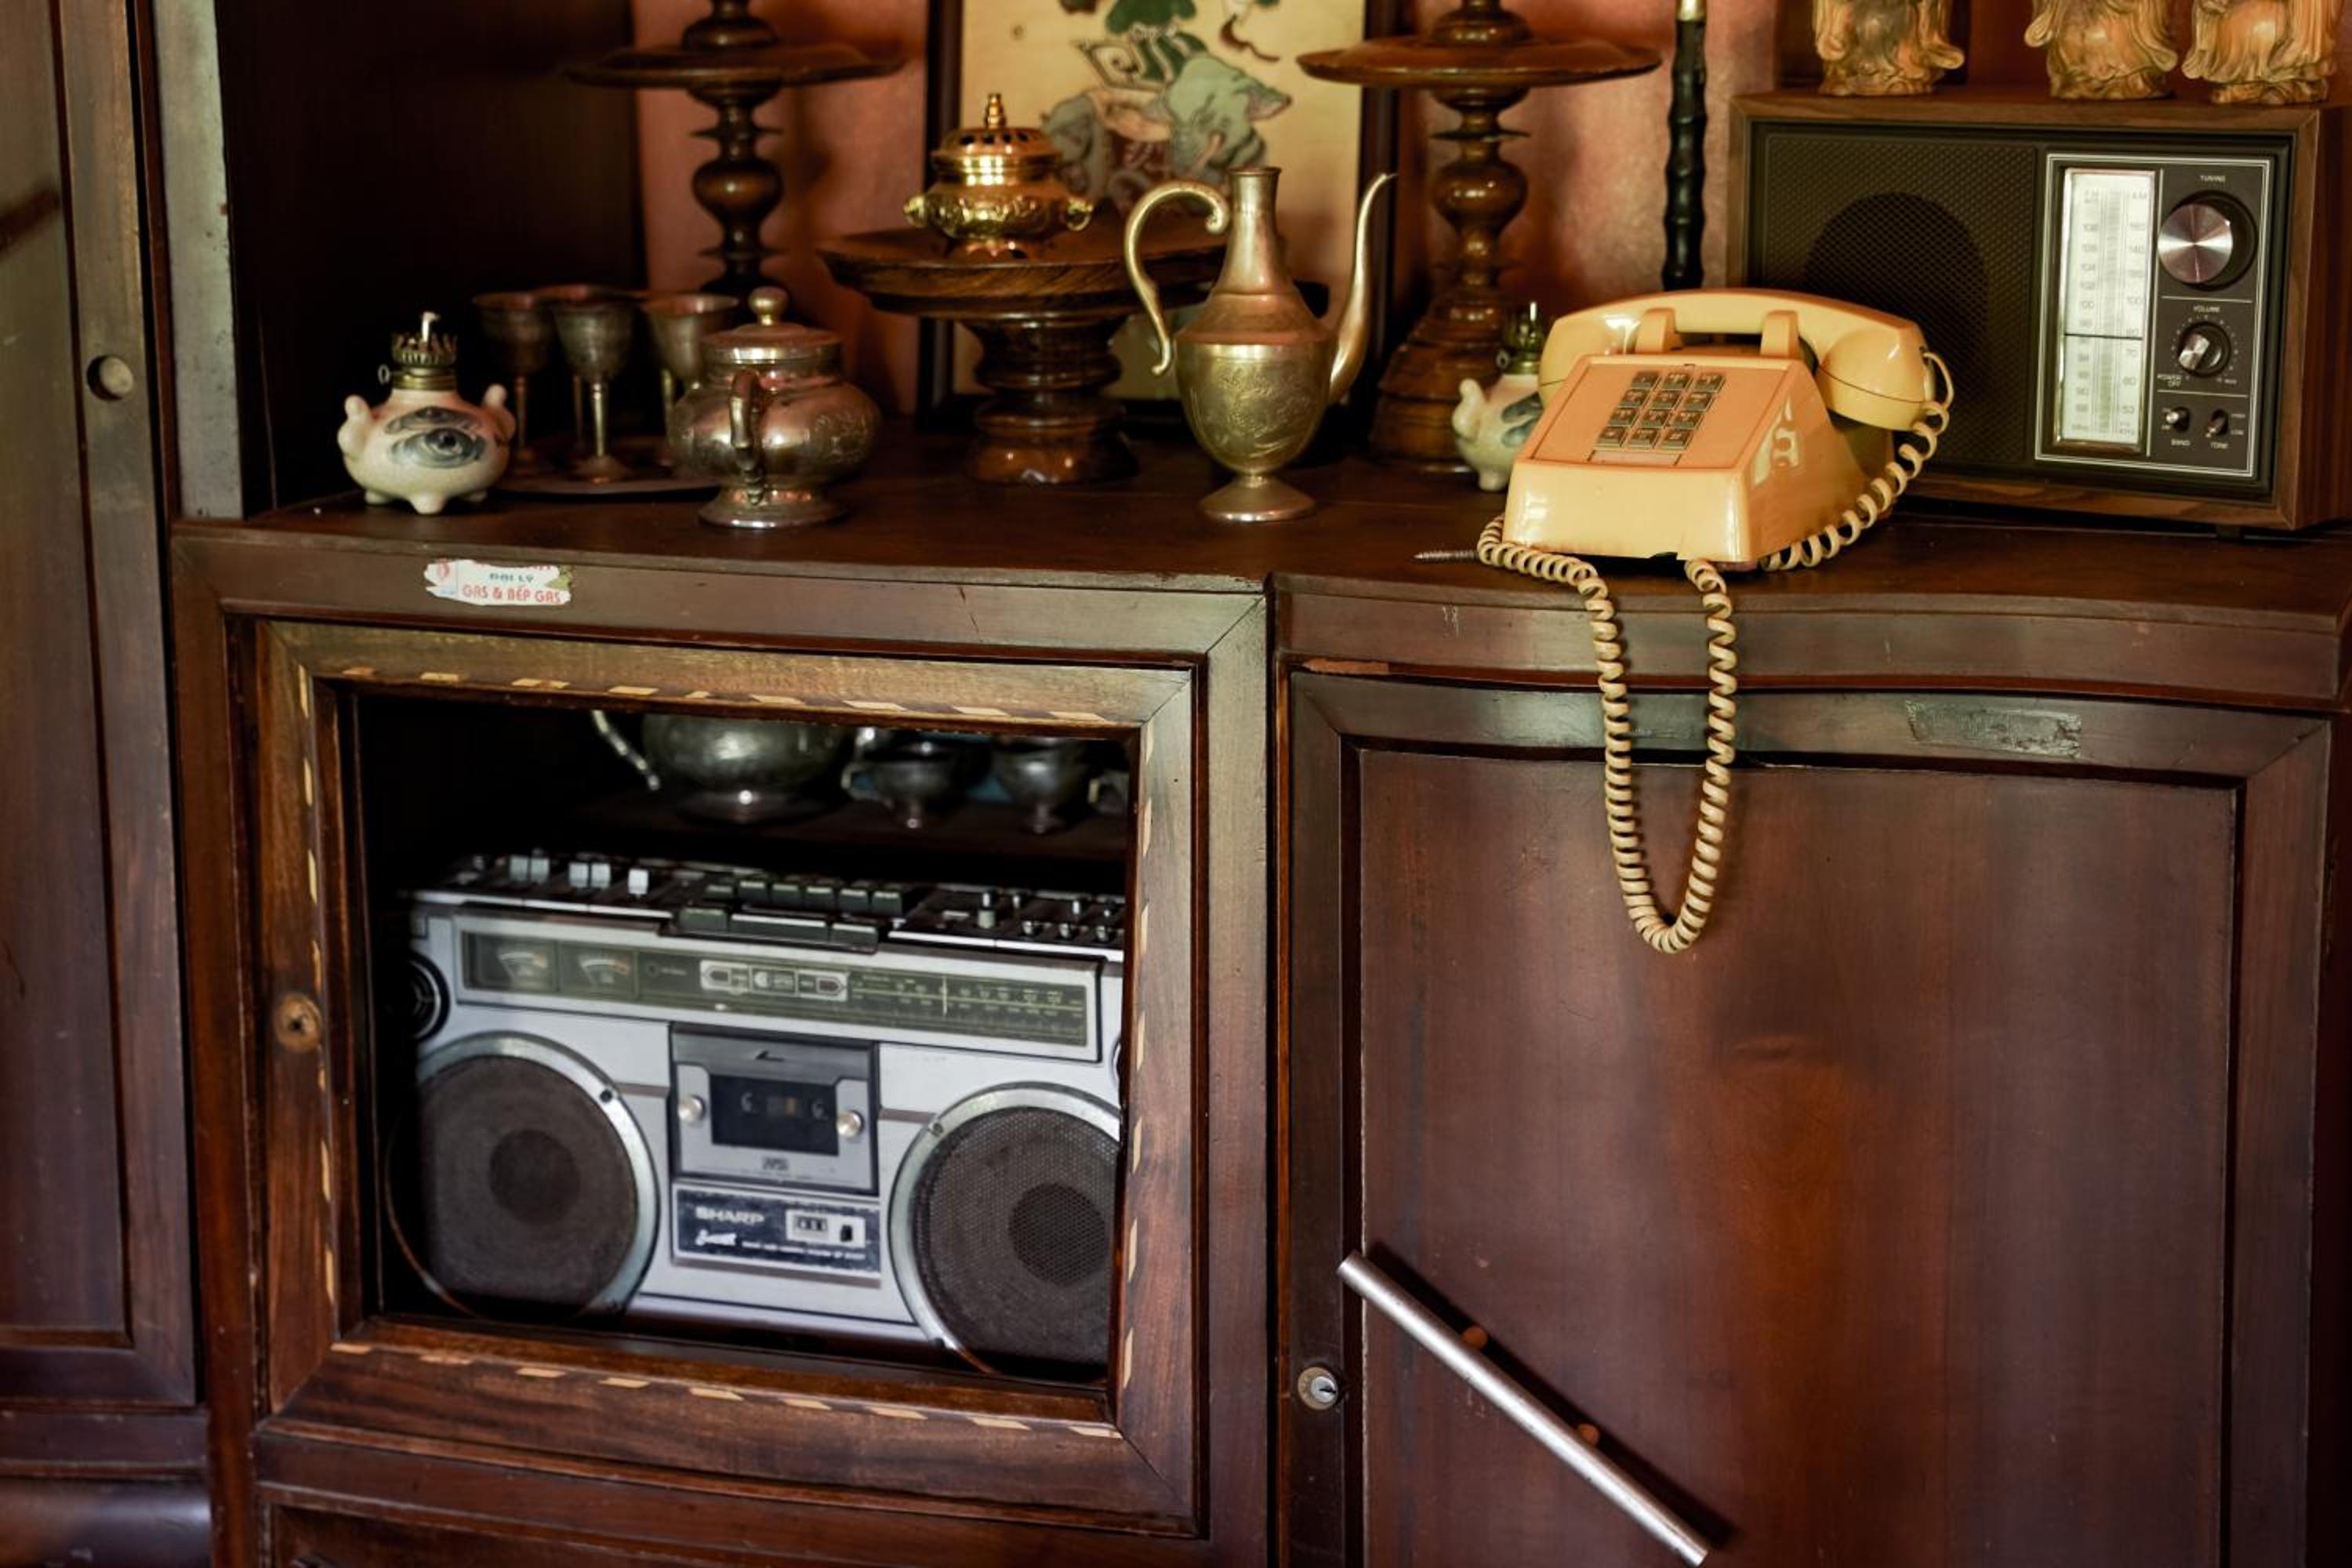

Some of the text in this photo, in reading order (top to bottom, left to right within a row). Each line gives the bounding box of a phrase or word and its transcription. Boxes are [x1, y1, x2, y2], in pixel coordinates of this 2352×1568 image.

[2080, 300, 2095, 309] 100
[463, 585, 488, 599] GAS
[535, 590, 561, 604] GAS
[695, 1206, 765, 1225] SHARP
